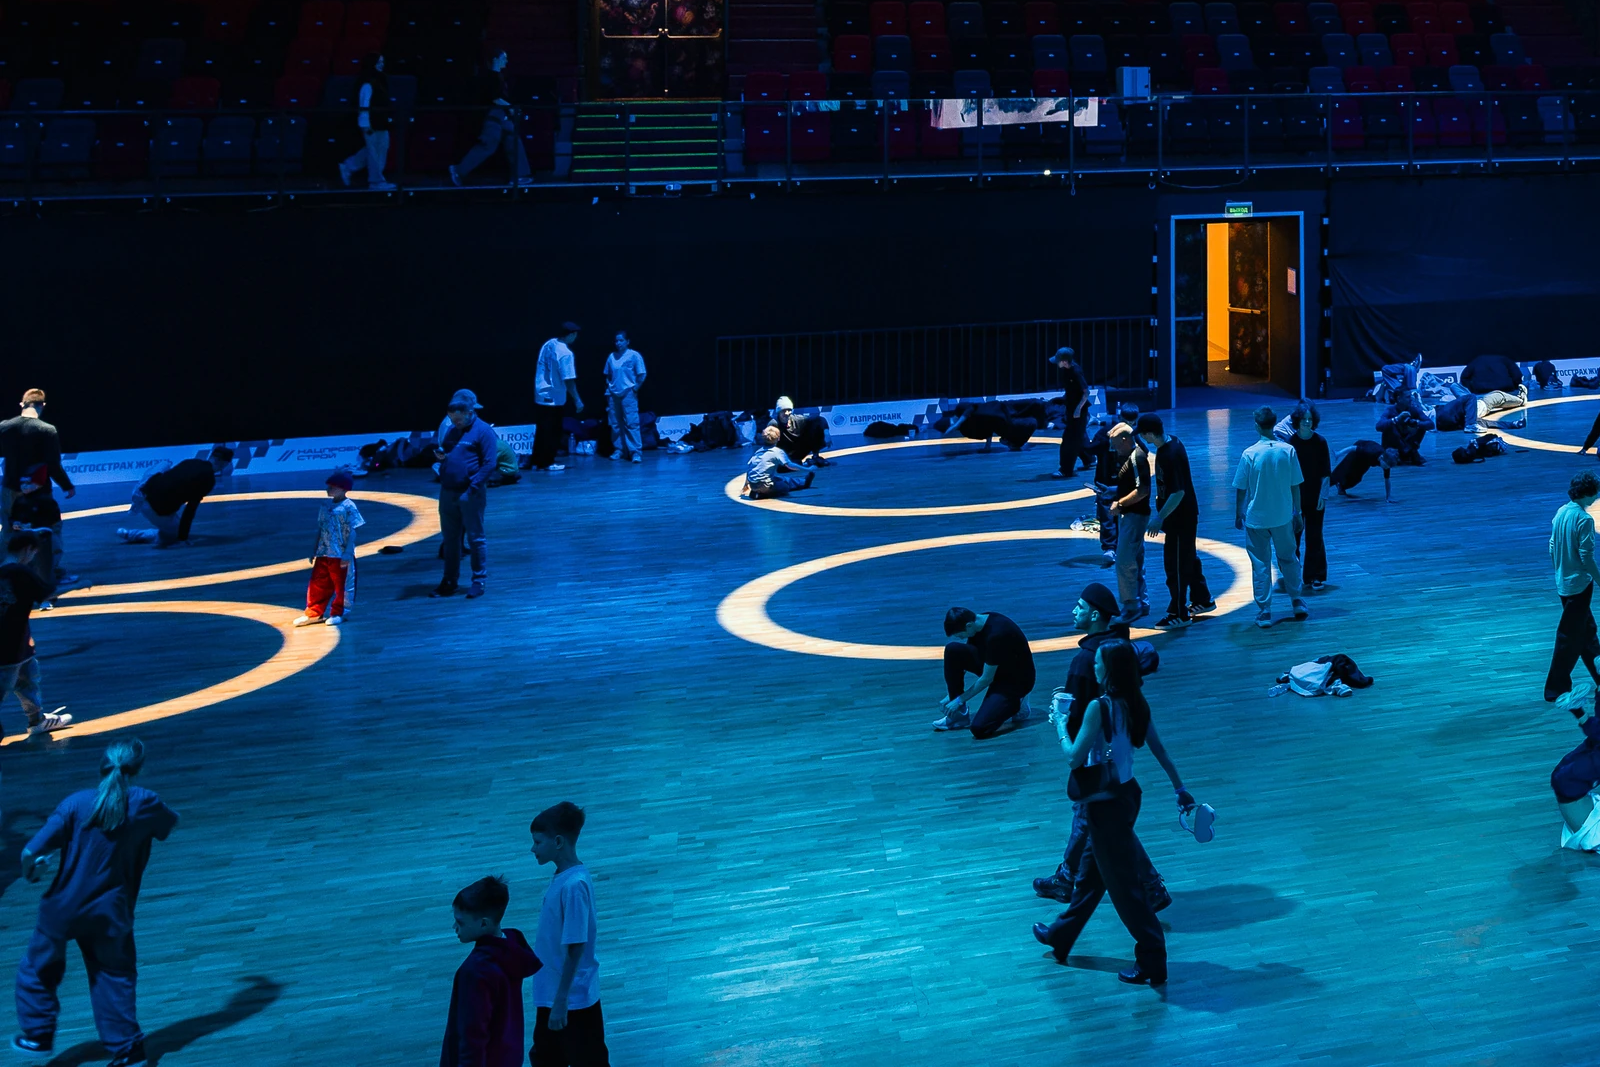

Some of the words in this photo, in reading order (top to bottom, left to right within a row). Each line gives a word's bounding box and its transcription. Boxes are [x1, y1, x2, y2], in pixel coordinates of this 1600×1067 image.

[850, 412, 902, 423] ГАЗПРОМБАНК
[297, 445, 362, 454] НАЦПРОЕК
[296, 453, 337, 461] СТРОЙ
